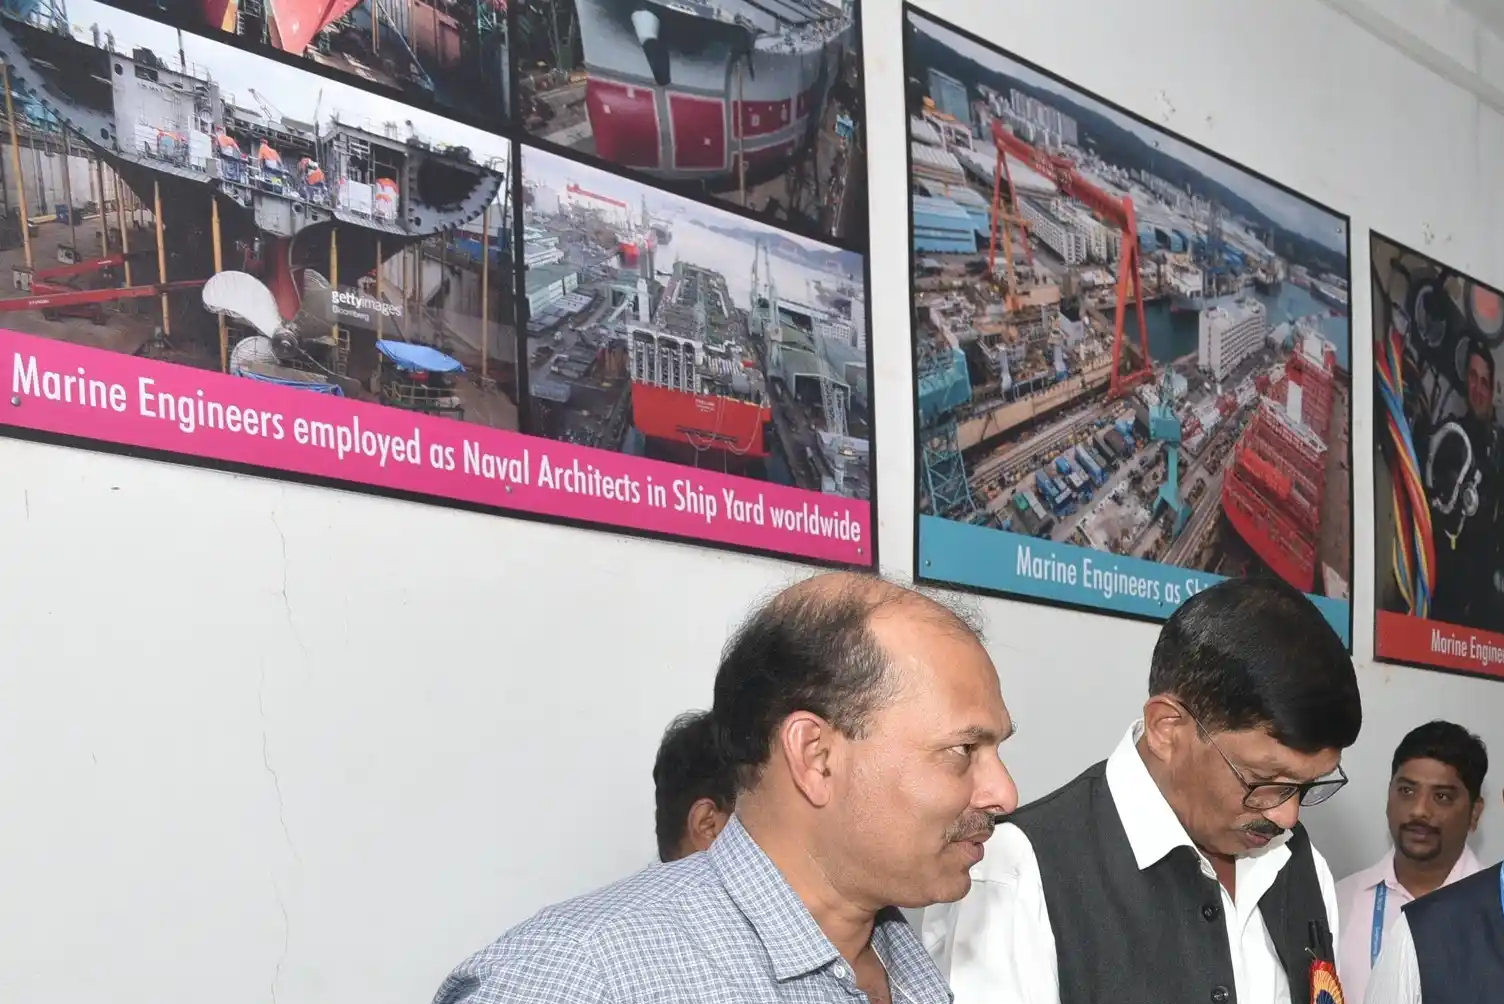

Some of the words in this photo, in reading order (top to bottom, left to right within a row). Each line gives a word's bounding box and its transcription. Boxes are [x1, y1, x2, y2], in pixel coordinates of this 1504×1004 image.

[331, 290, 403, 317] gettyimages
[12, 353, 127, 412] Marine
[138, 376, 285, 440] Engineers
[293, 415, 421, 467] employed
[429, 444, 456, 472] as
[463, 439, 530, 486] Naval
[538, 454, 641, 504] Architects
[646, 475, 667, 509] in
[672, 479, 718, 524] Ship
[721, 487, 765, 526] Yard
[769, 499, 861, 543] worldwide
[1016, 544, 1077, 586] Marine
[1083, 558, 1161, 600] Engineers
[1164, 582, 1181, 605] as
[1431, 628, 1467, 657] Marine
